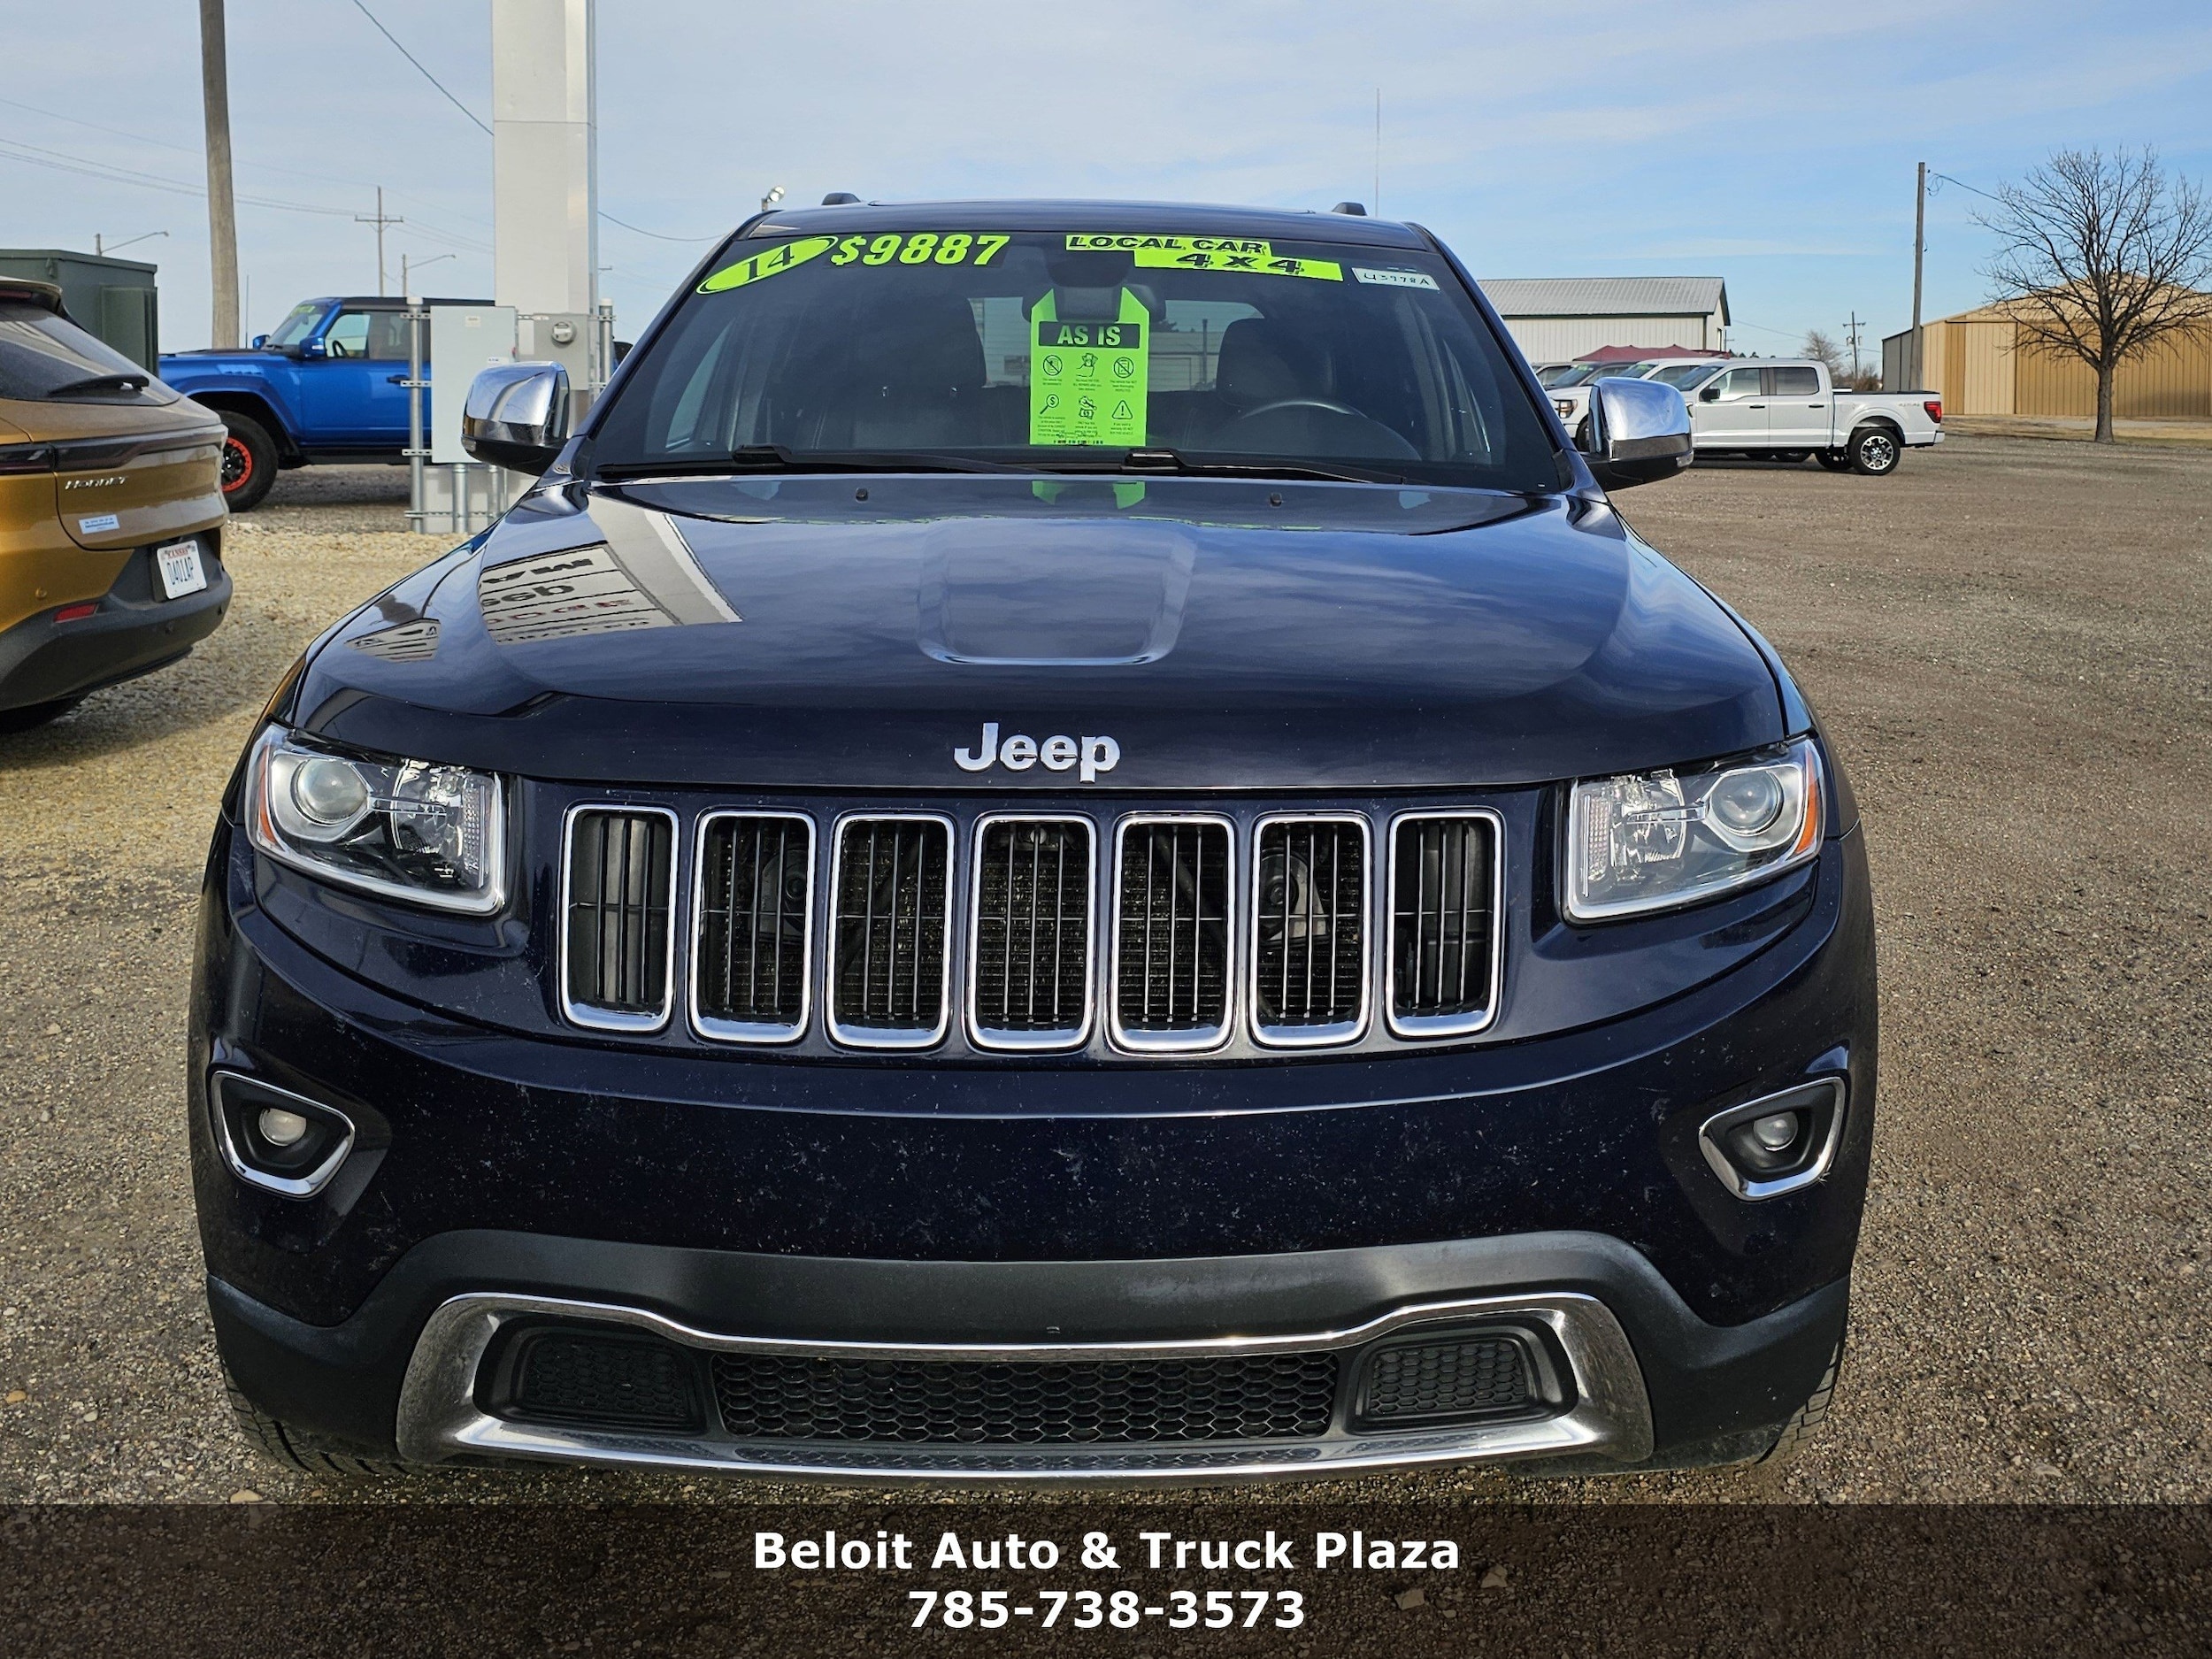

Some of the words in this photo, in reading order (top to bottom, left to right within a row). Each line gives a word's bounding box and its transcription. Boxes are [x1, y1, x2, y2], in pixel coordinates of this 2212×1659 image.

[830, 234, 1011, 266] $9887
[1069, 235, 1186, 251] LOCAL
[1191, 238, 1268, 257] CAR
[741, 244, 795, 282] 14
[1176, 252, 1214, 269] 4
[1267, 258, 1305, 275] 4
[1056, 325, 1089, 346] AS
[1097, 326, 1121, 347] IS
[954, 722, 1120, 783] Jeep
